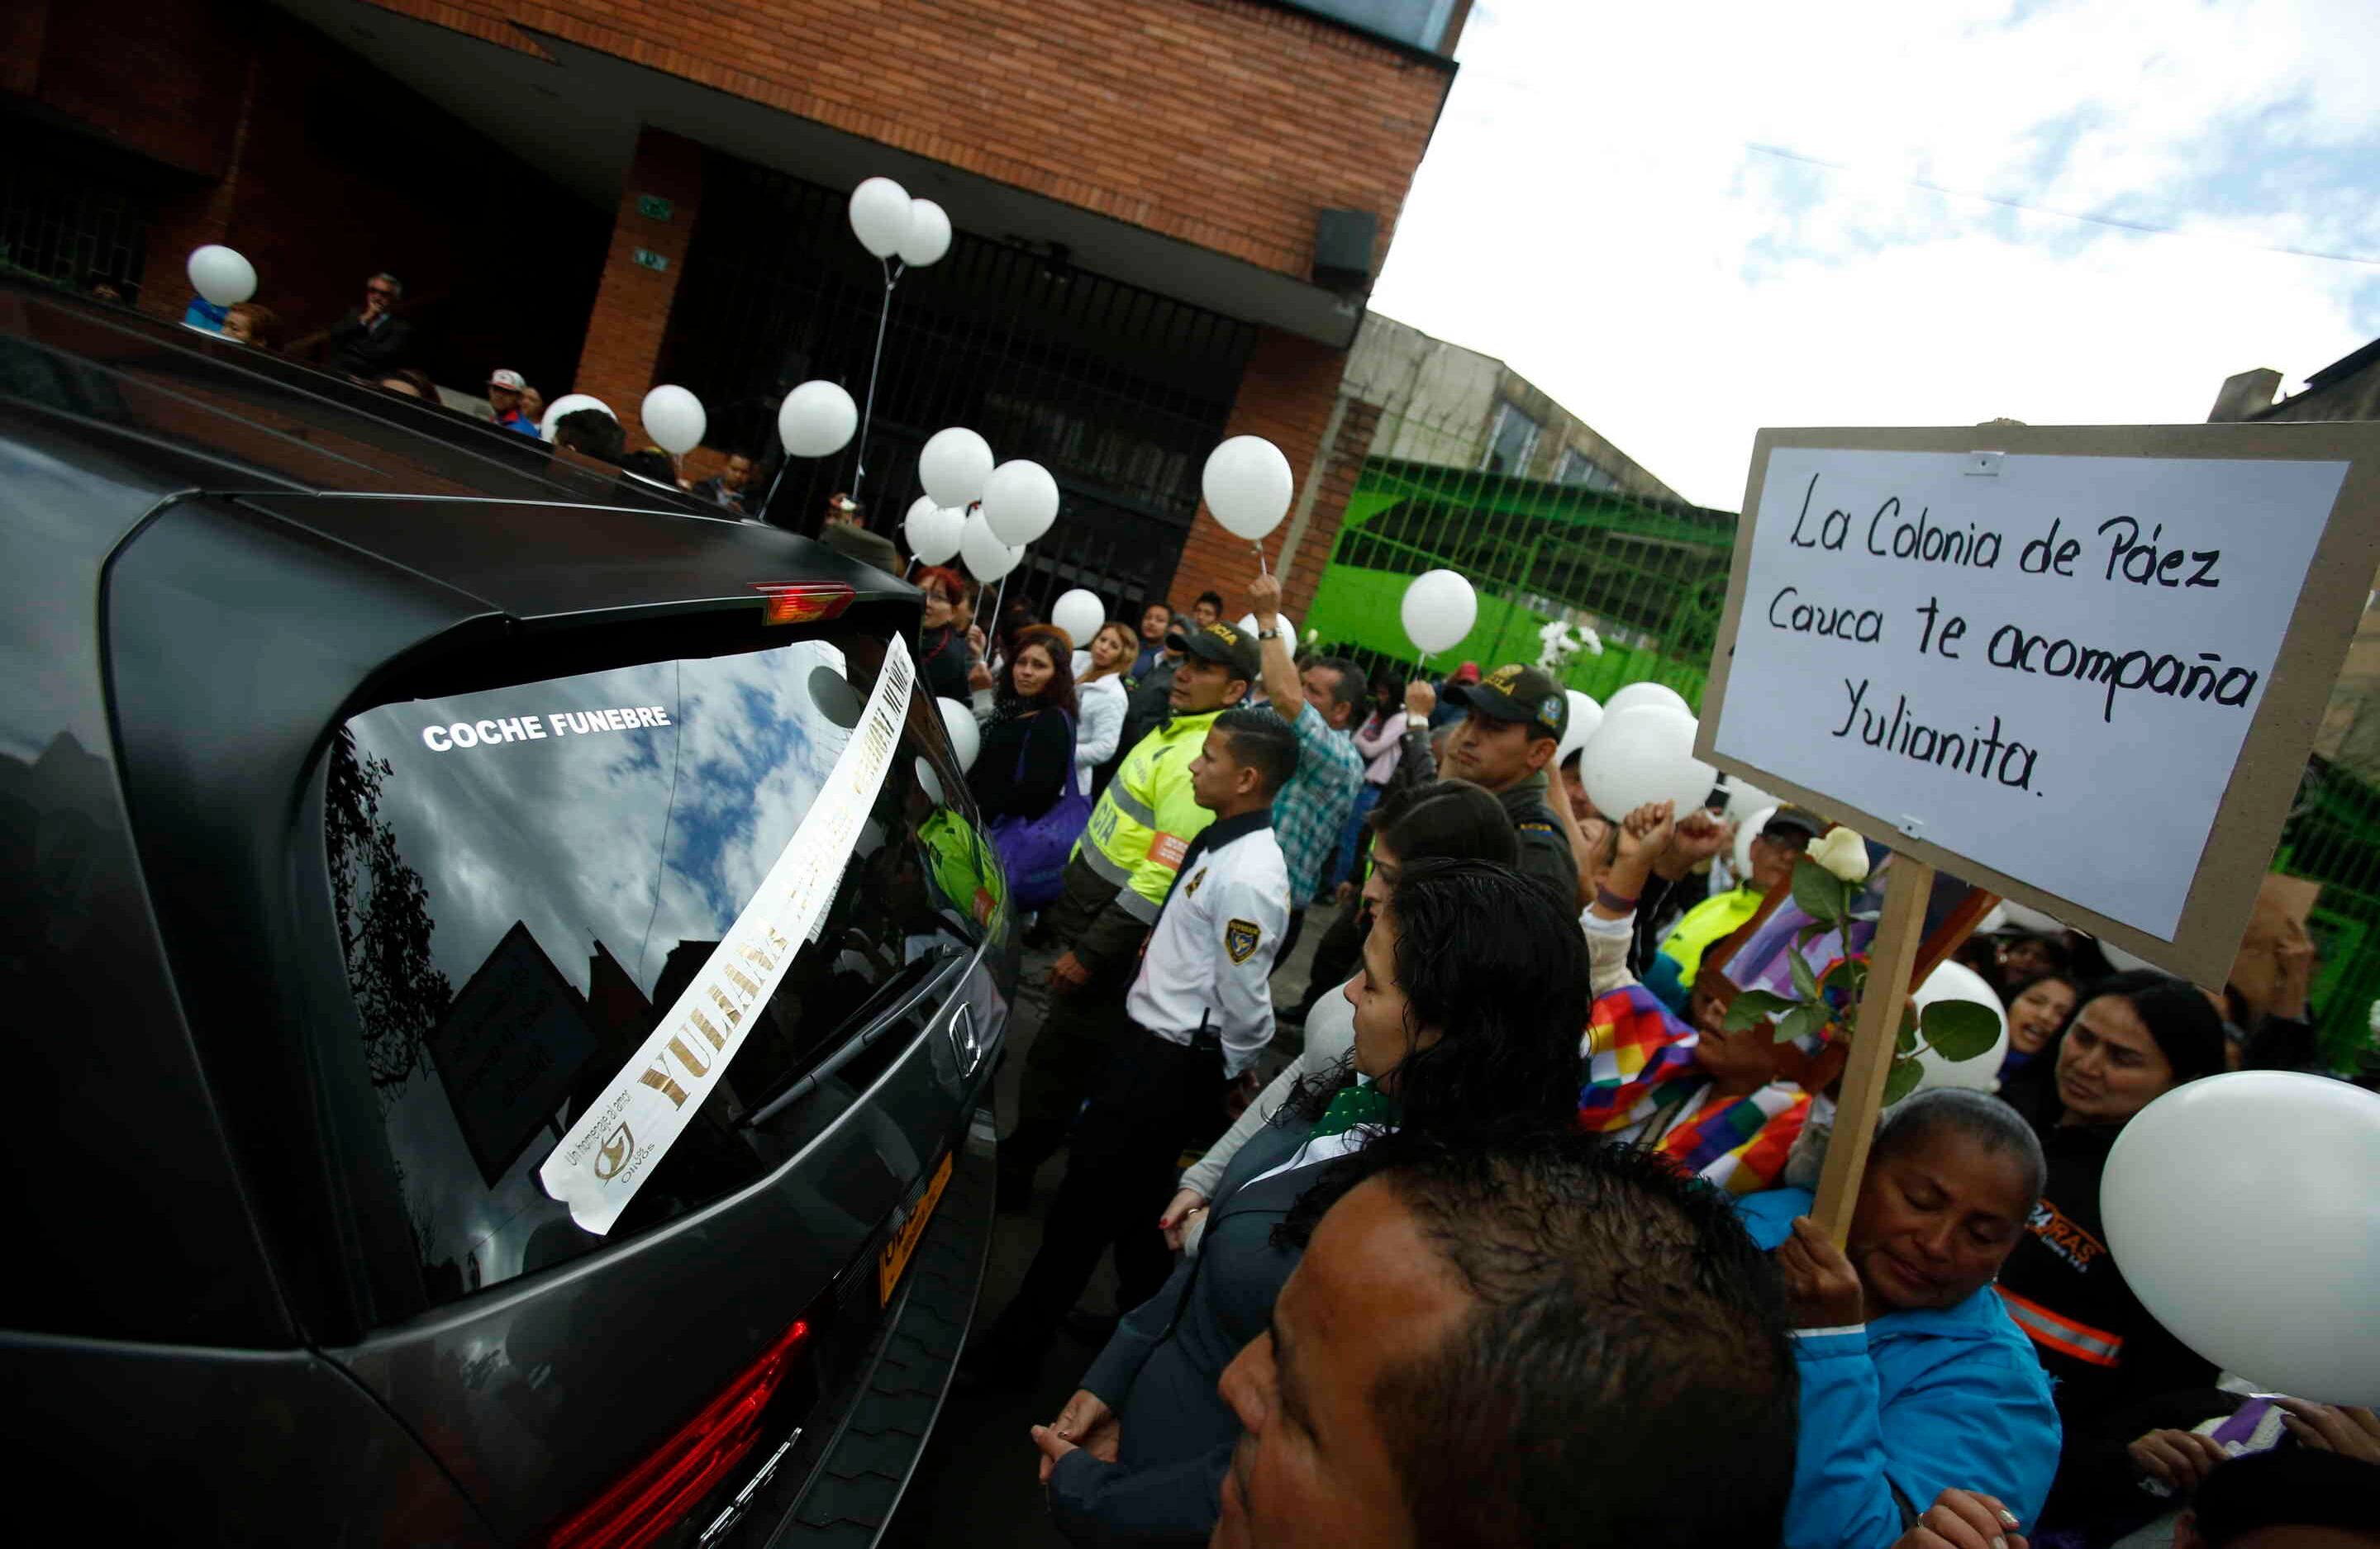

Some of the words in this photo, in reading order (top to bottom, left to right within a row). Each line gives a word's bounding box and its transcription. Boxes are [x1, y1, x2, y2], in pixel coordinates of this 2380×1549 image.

[1791, 473, 1851, 550] La
[1868, 497, 2002, 568] Colonia
[2020, 517, 2081, 577] de
[2098, 516, 2221, 587] Páez
[1769, 587, 1883, 644] Cauca
[1916, 596, 1967, 658] te
[1987, 625, 2258, 723] acompaña
[423, 716, 547, 752] COCHE
[548, 706, 672, 737] FUNEBRE
[1832, 678, 2043, 797] Yulianita.
[636, 919, 788, 1111] YULIANA
[564, 1149, 579, 1167] Un
[576, 1116, 612, 1156] homenaje
[607, 1105, 618, 1119] al
[613, 1090, 632, 1112] amor
